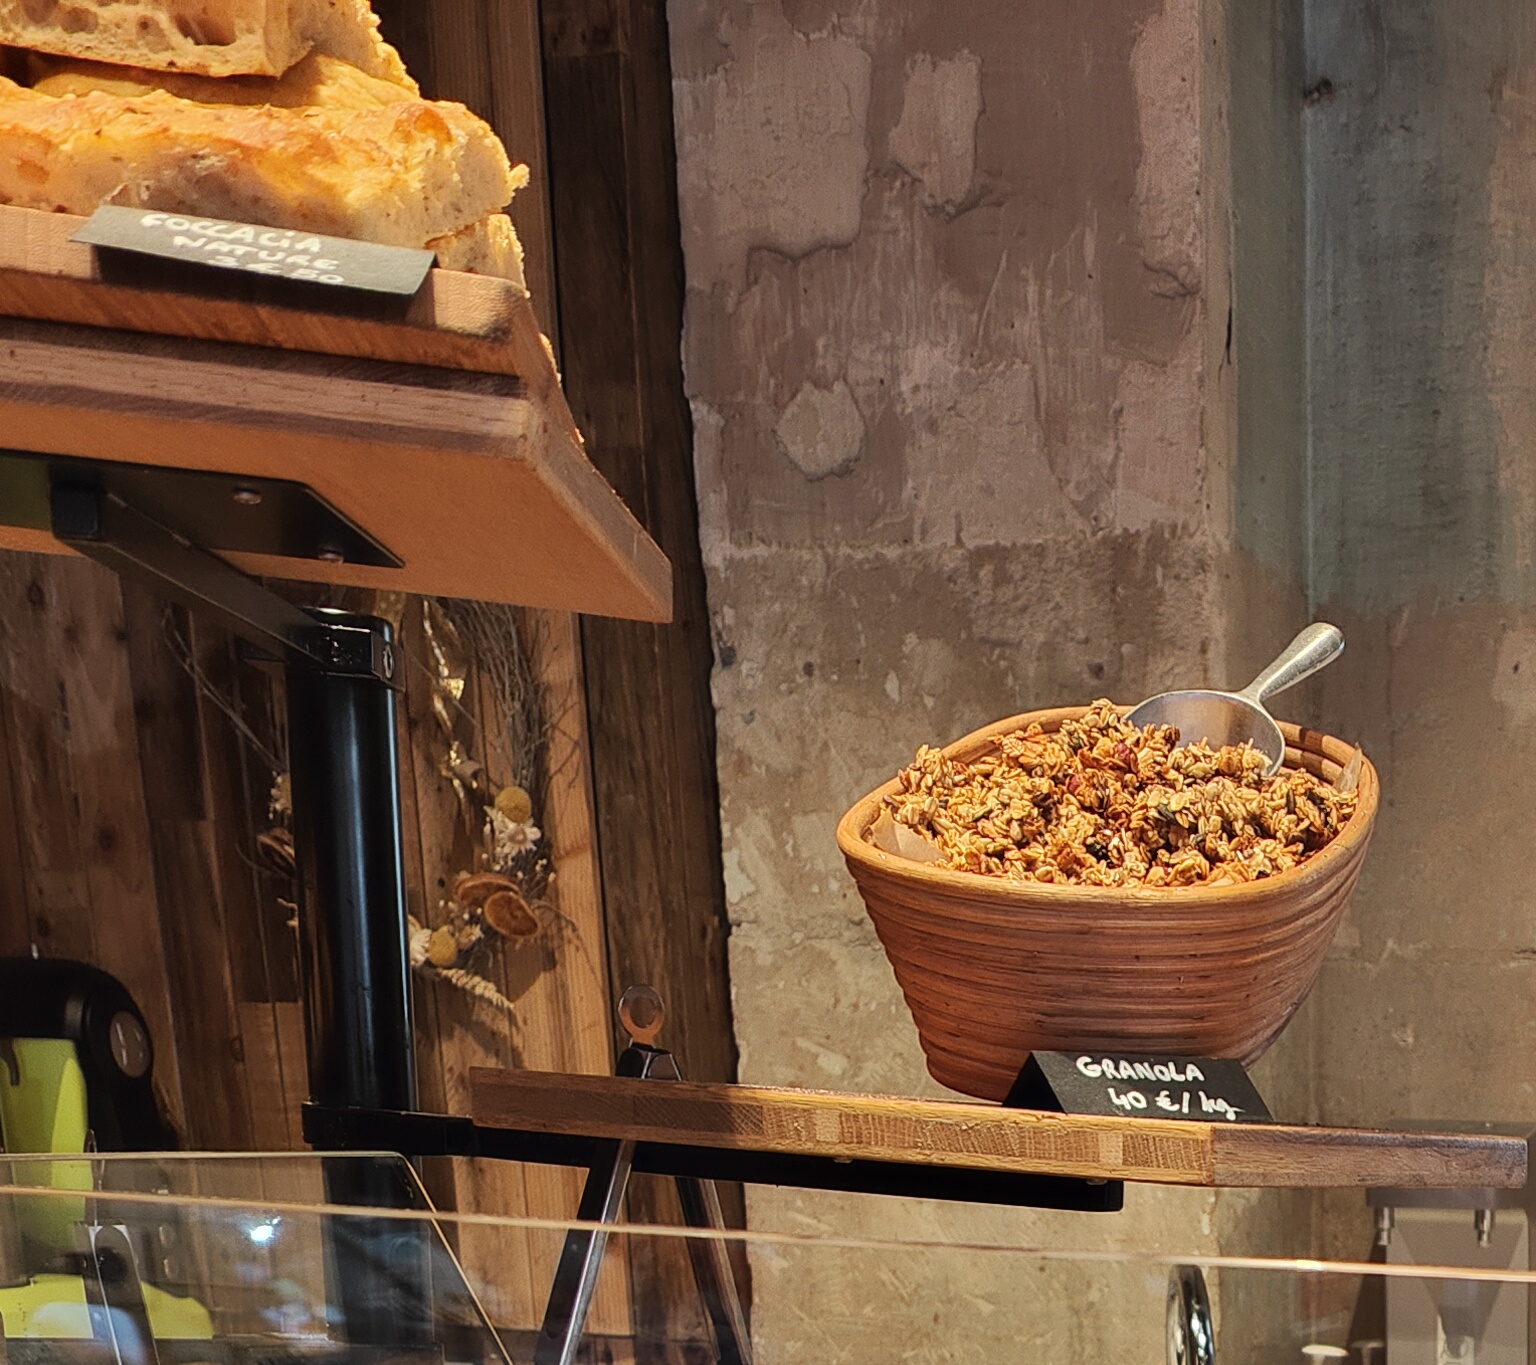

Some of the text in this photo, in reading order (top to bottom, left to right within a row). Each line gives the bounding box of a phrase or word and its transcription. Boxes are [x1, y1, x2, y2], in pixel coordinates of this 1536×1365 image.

[172, 236, 340, 270] NATURE
[1075, 1055, 1205, 1082] GRANOLA
[1107, 1087, 1147, 1110] 40
